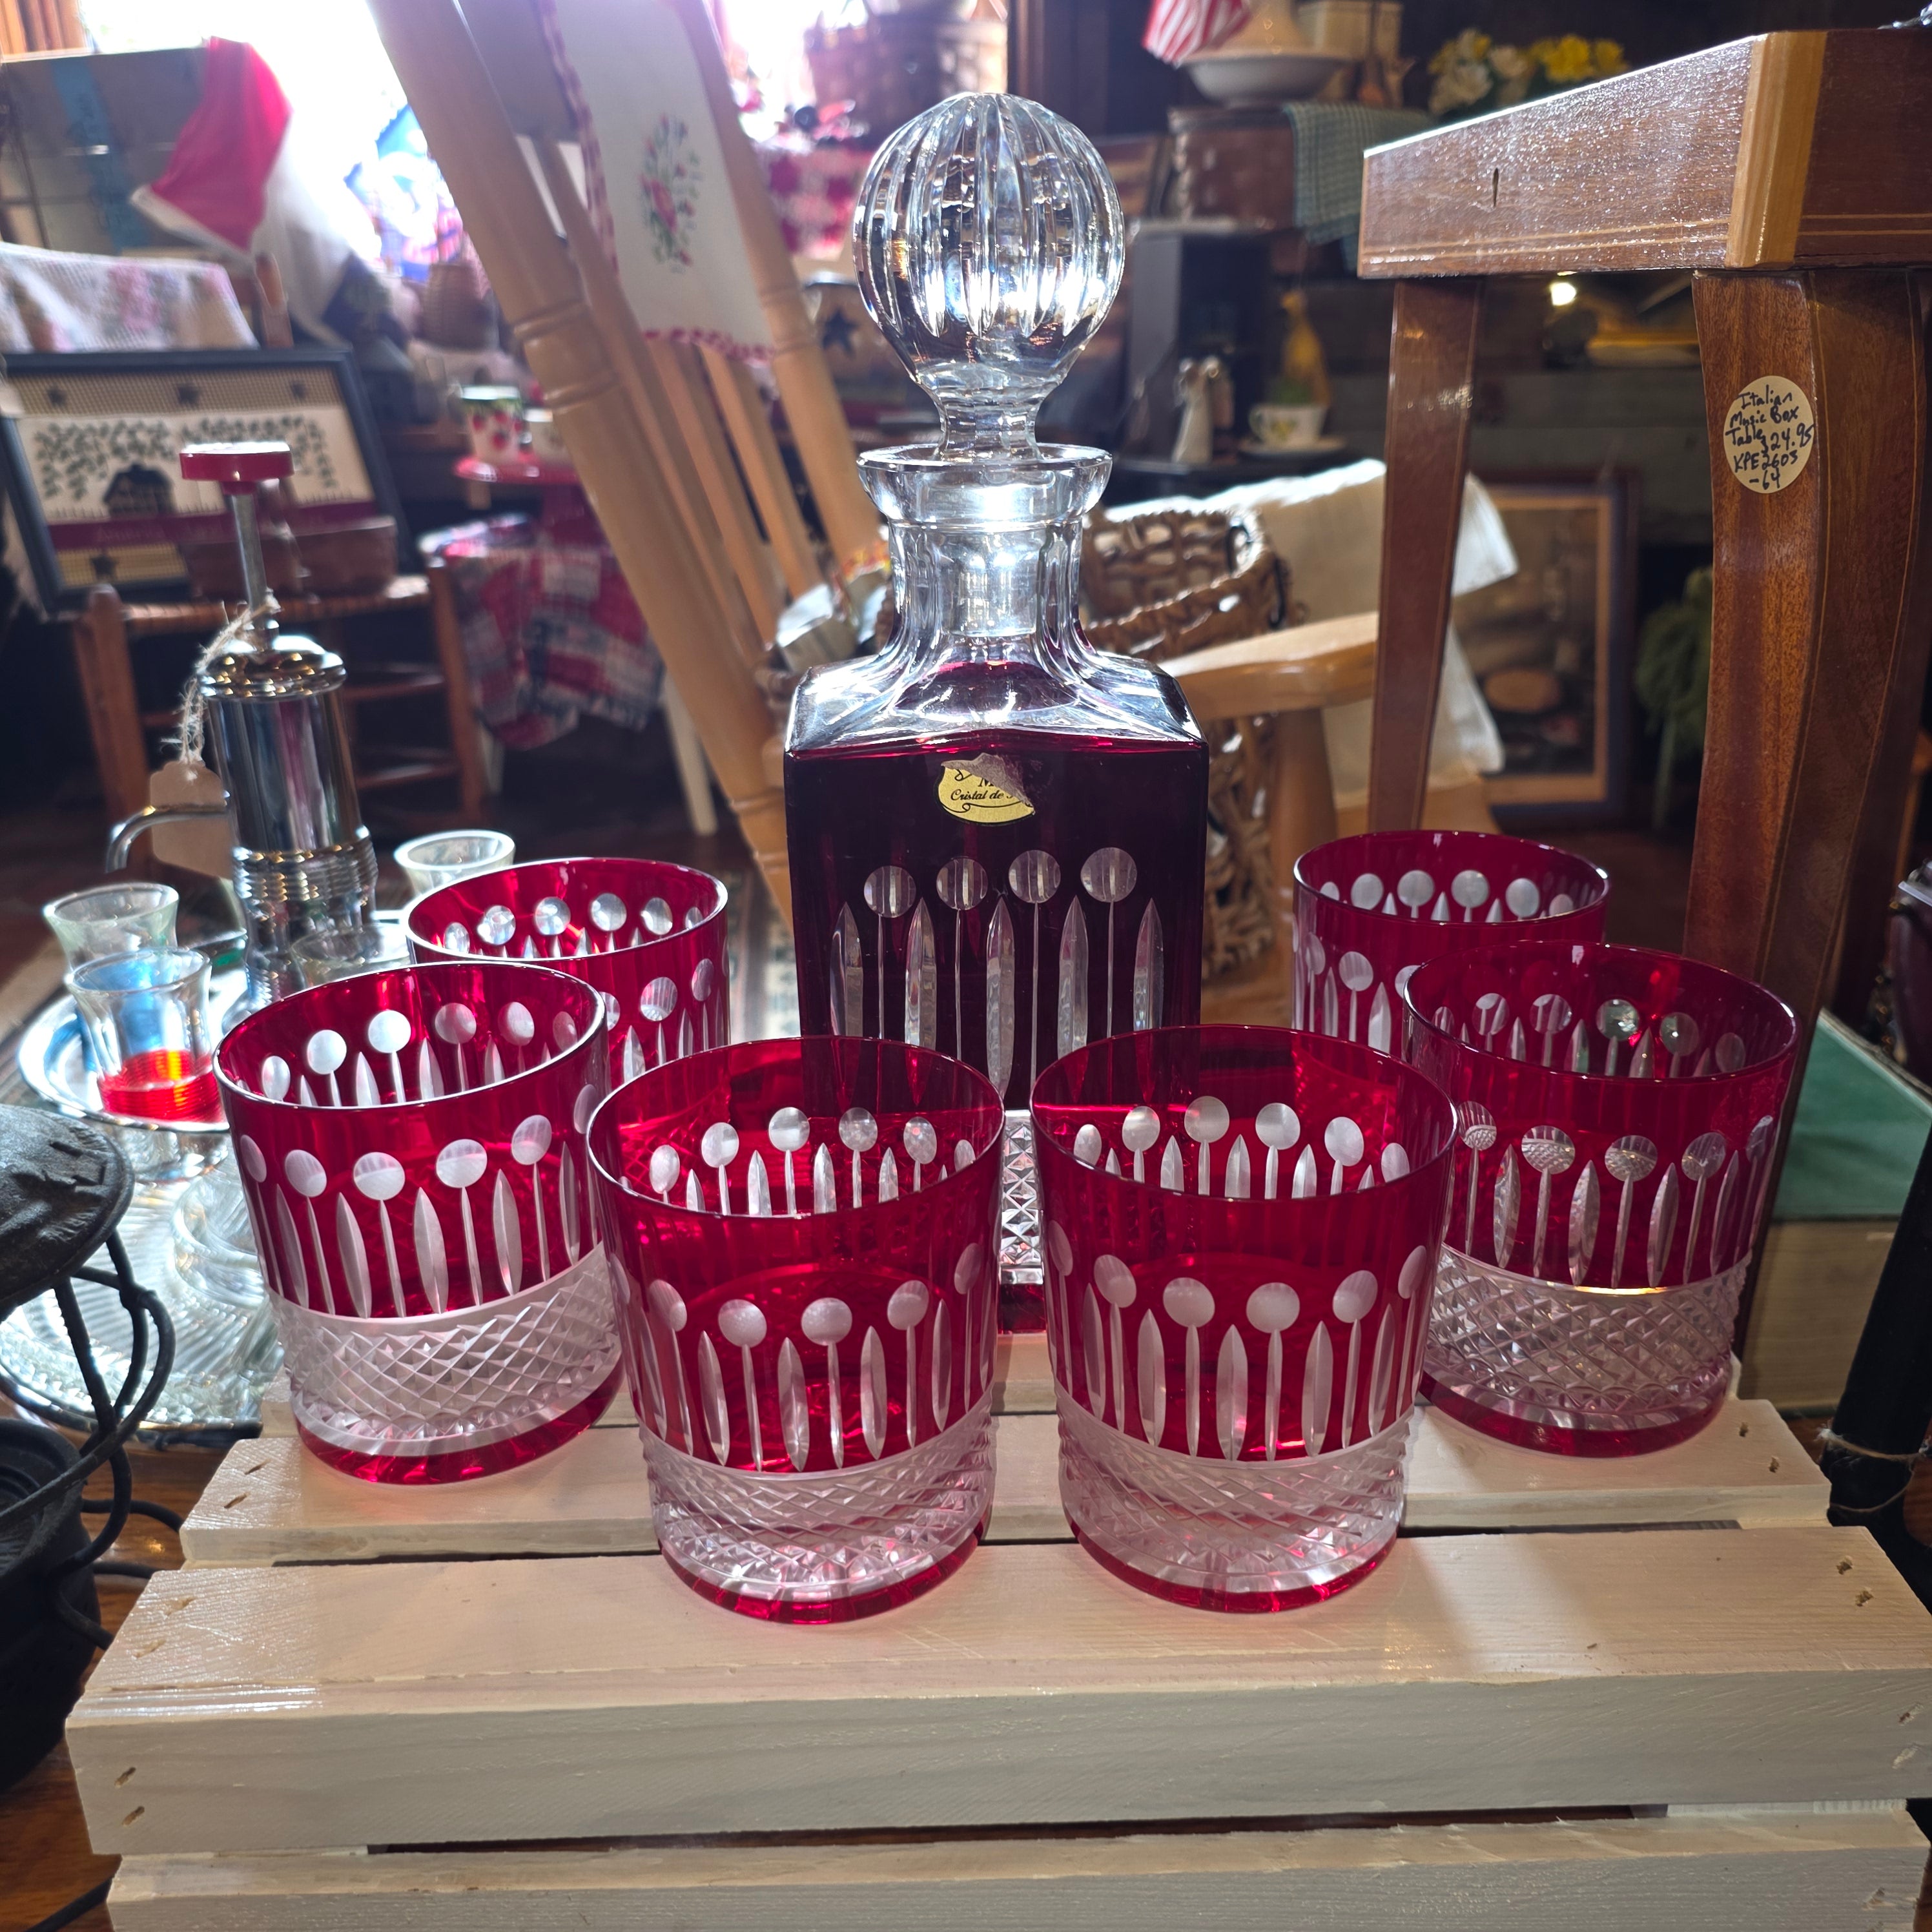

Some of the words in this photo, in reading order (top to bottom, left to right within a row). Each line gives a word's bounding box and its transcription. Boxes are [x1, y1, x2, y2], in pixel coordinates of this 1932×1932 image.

[1736, 384, 1793, 409] Italian
[1729, 410, 1767, 428] Music
[1770, 406, 1800, 424] Box
[950, 788, 989, 801] Cristal
[989, 790, 1004, 799] de
